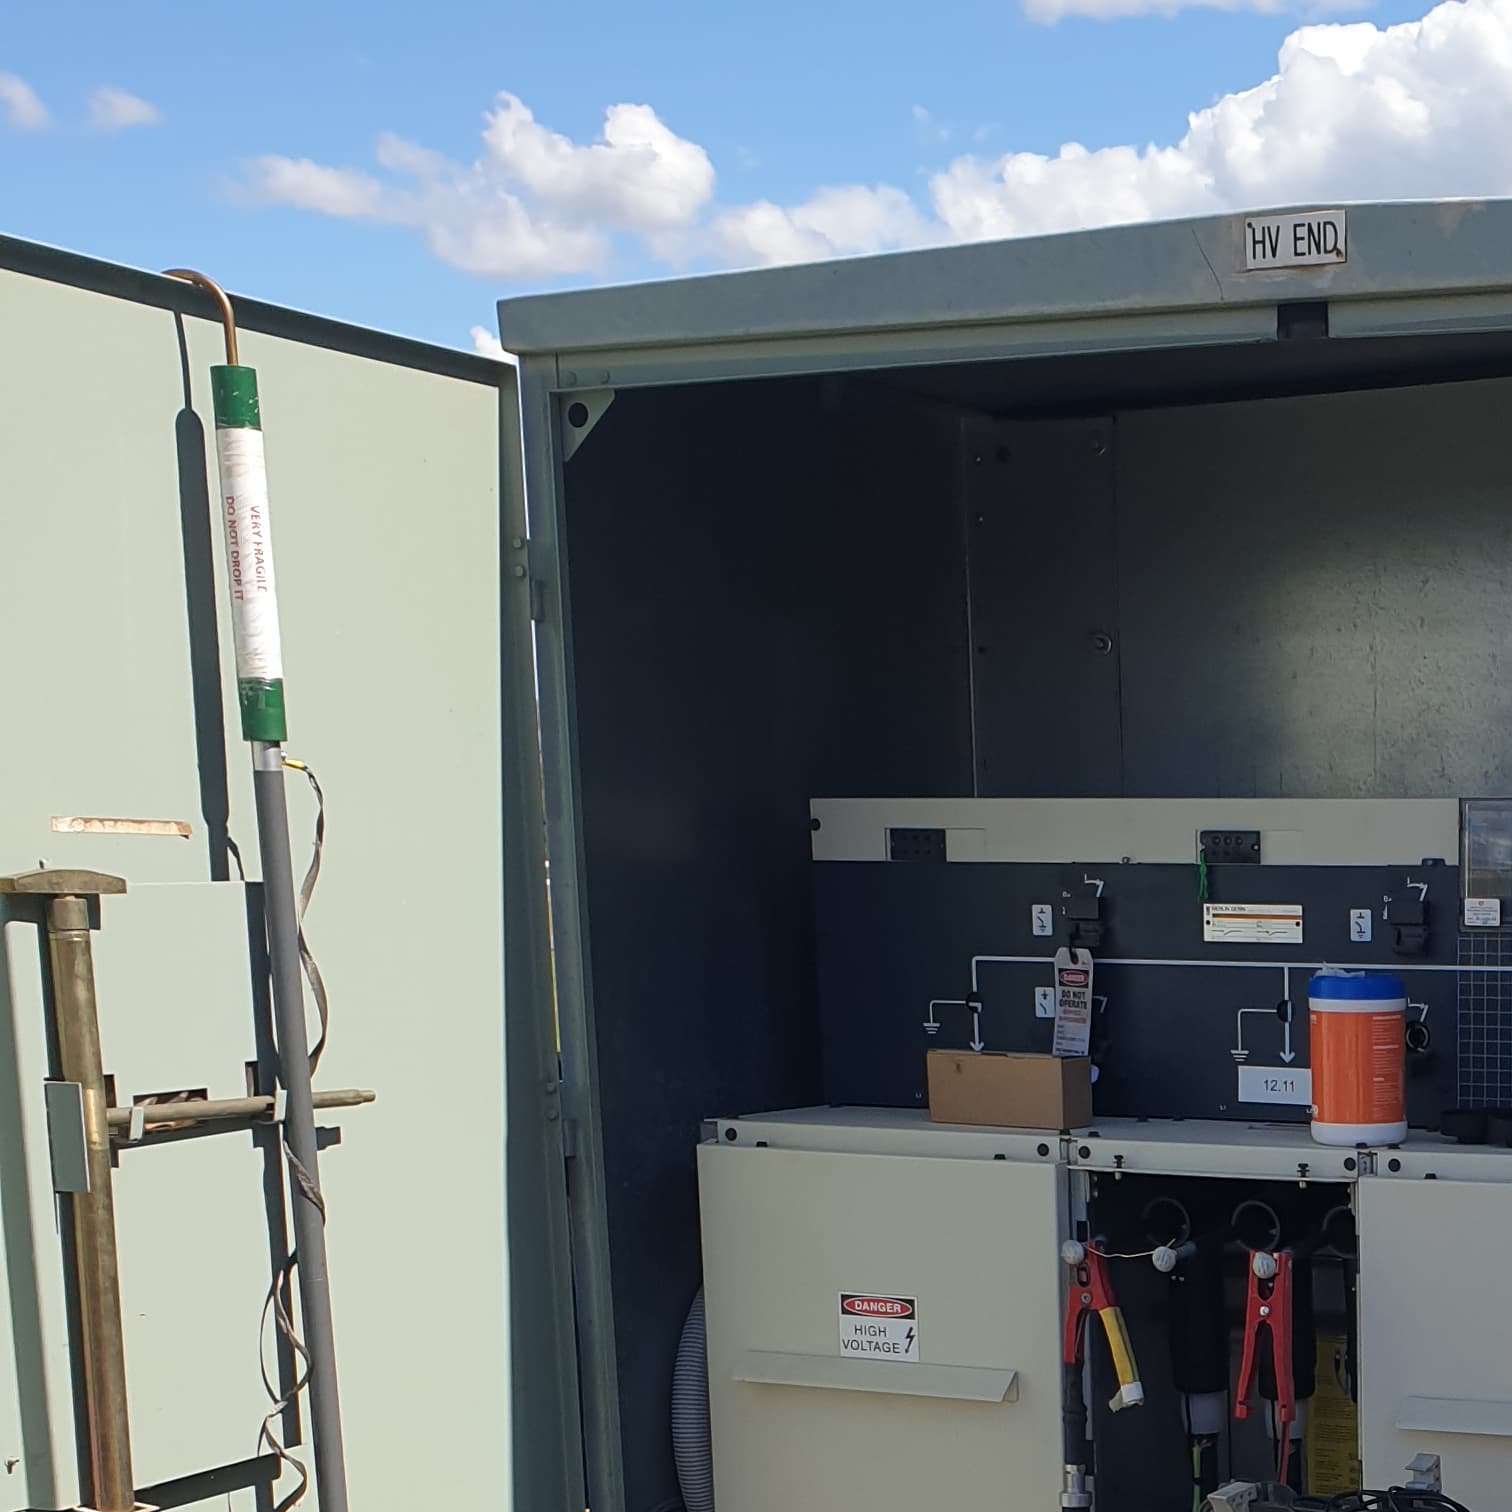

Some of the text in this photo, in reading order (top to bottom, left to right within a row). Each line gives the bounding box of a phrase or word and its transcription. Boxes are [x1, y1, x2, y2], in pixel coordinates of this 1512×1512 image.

[1252, 221, 1338, 259] HV END
[225, 496, 244, 601] DO NOT DROP IT
[250, 505, 268, 593] VERY FRAGILE
[1264, 1080, 1295, 1092] 12.11
[855, 1300, 901, 1313] DANGER
[854, 1324, 887, 1338] HIGH
[842, 1339, 901, 1354] VOLTAGE
